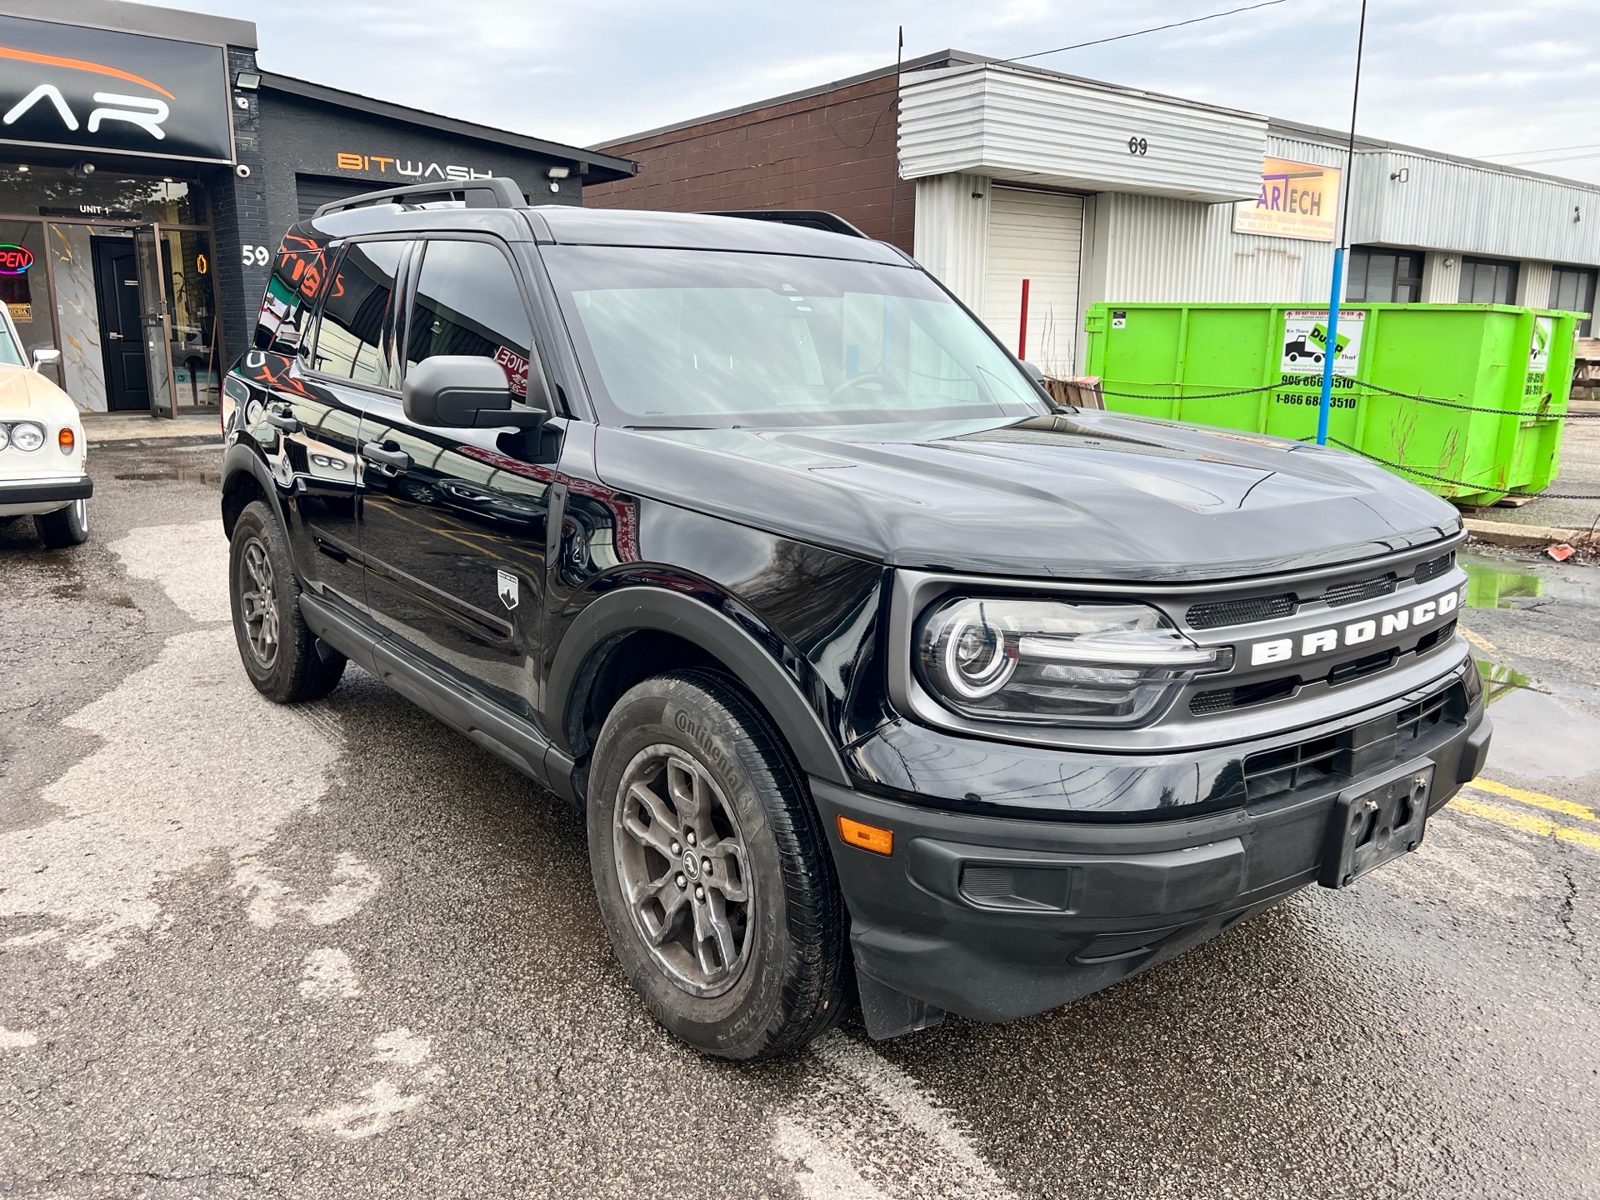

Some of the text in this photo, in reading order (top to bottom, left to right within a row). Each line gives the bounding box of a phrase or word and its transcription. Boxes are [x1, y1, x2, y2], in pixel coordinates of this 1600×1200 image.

[1128, 136, 1148, 156] 69
[337, 152, 493, 180] BITWASH
[80, 205, 103, 215] UNIT
[242, 245, 270, 266] 59
[1310, 328, 1343, 353] Dup
[1275, 393, 1357, 409] 1-866 68 3510
[1250, 591, 1458, 667] BRONCO
[674, 709, 747, 797] Continental
